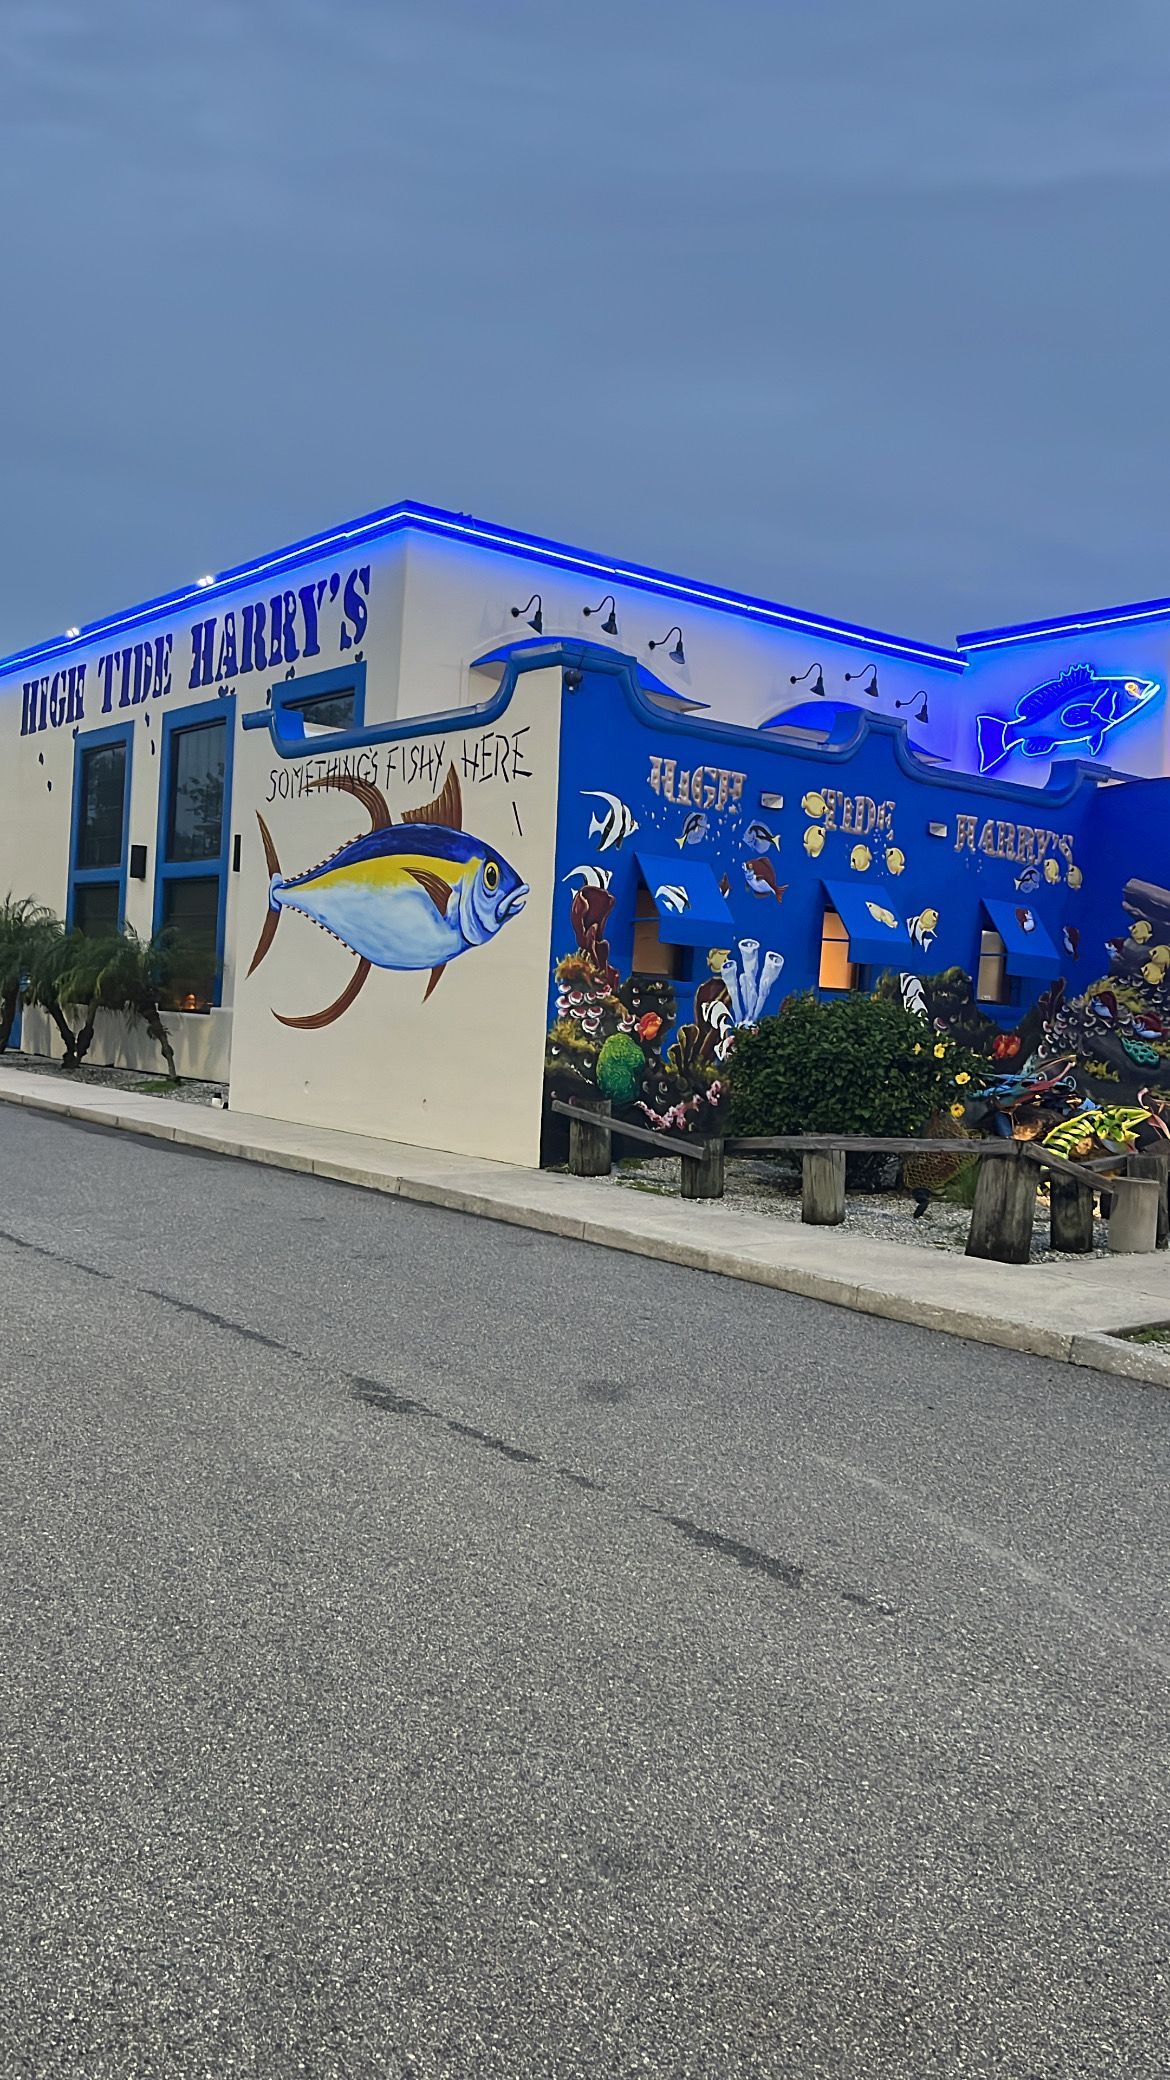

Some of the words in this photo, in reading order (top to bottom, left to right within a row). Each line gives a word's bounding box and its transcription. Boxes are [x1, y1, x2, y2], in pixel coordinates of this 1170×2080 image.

[20, 664, 87, 736] HIGH
[98, 634, 173, 713] TIDE
[188, 565, 371, 689] HARRY'S
[265, 746, 379, 802] SOMETHING'S
[386, 739, 446, 794] FISHY
[460, 726, 533, 783] HERE
[648, 755, 748, 814] HIGH
[820, 787, 897, 840] TIDE
[954, 814, 1074, 865] HARRY'S
